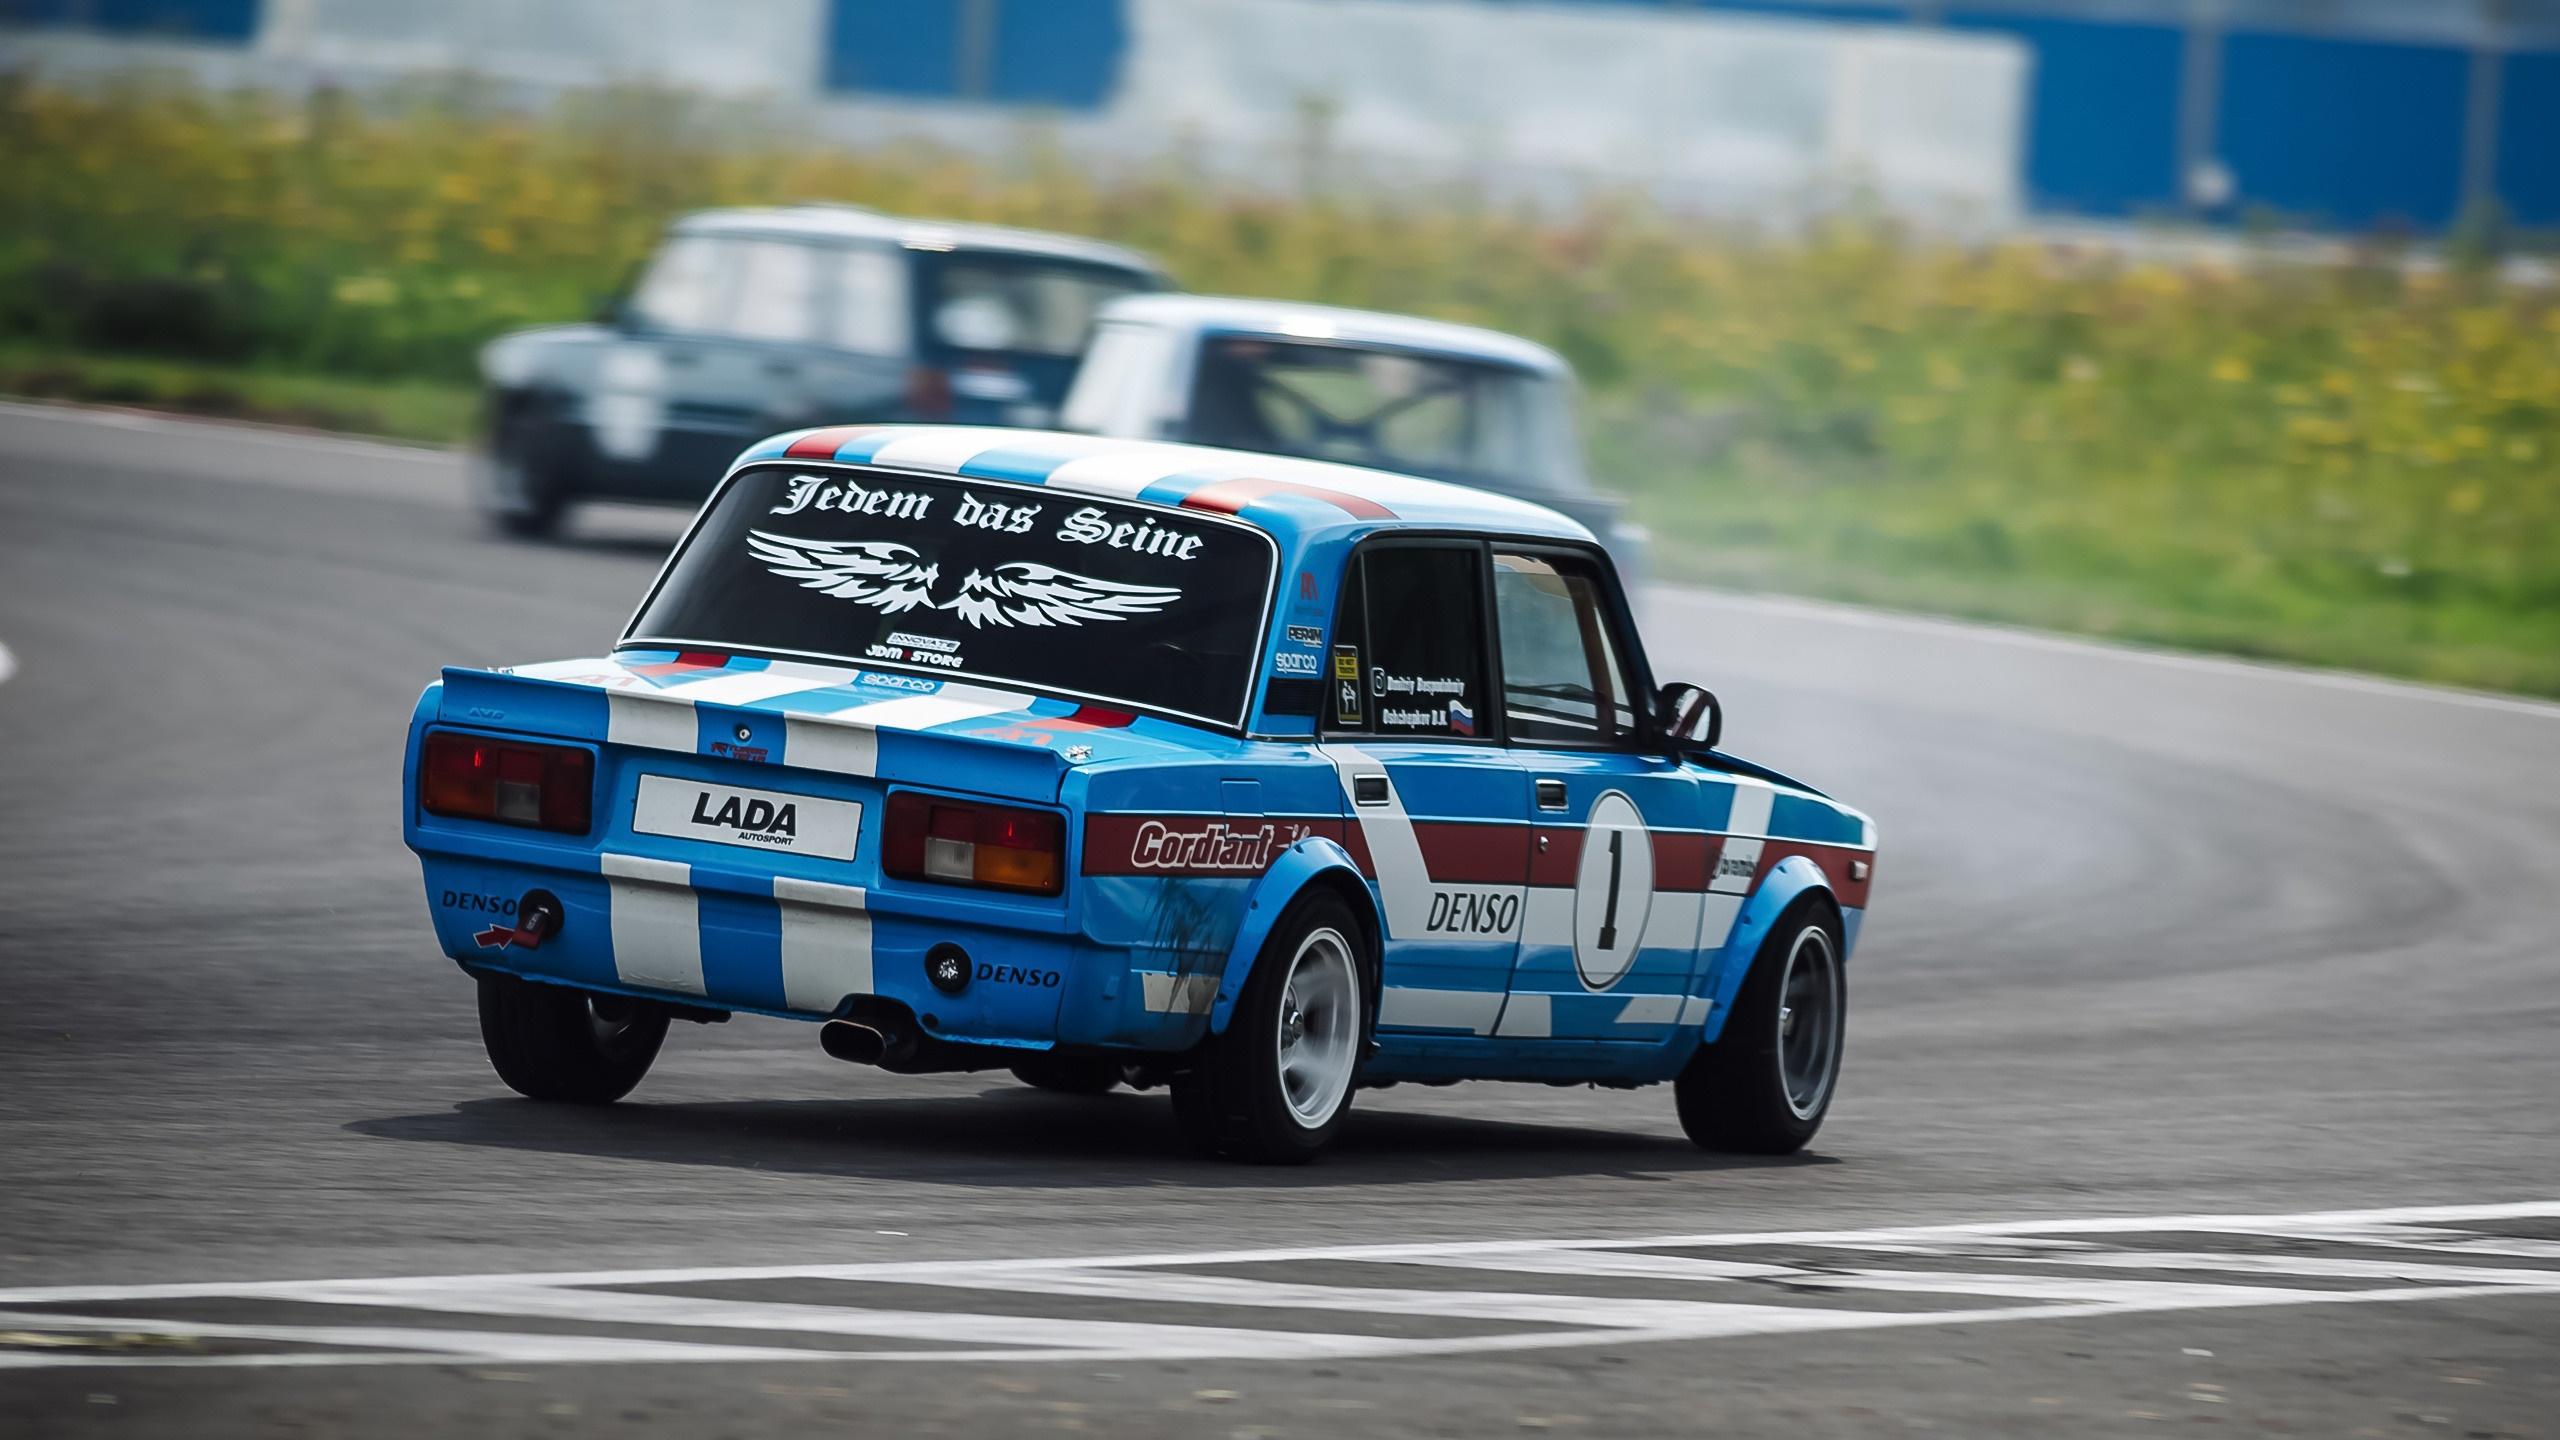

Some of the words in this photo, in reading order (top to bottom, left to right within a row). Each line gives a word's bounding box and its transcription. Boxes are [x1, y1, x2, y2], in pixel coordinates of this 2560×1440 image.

[770, 475, 934, 521] Jedem
[953, 491, 1042, 534] das
[1056, 506, 1204, 561] Seine
[892, 634, 957, 650] INNOVATE
[865, 644, 903, 660] JDM
[910, 651, 964, 668] STORE
[1275, 653, 1317, 674] sparco
[863, 674, 935, 691] sparco
[691, 792, 796, 836] LADA
[738, 831, 794, 846] AUTOSPORT
[1131, 820, 1275, 869] Cordiant
[1597, 830, 1622, 950] 1
[442, 890, 517, 916] DENSO
[1426, 892, 1519, 934] DENSO
[976, 963, 1061, 988] DENSO
